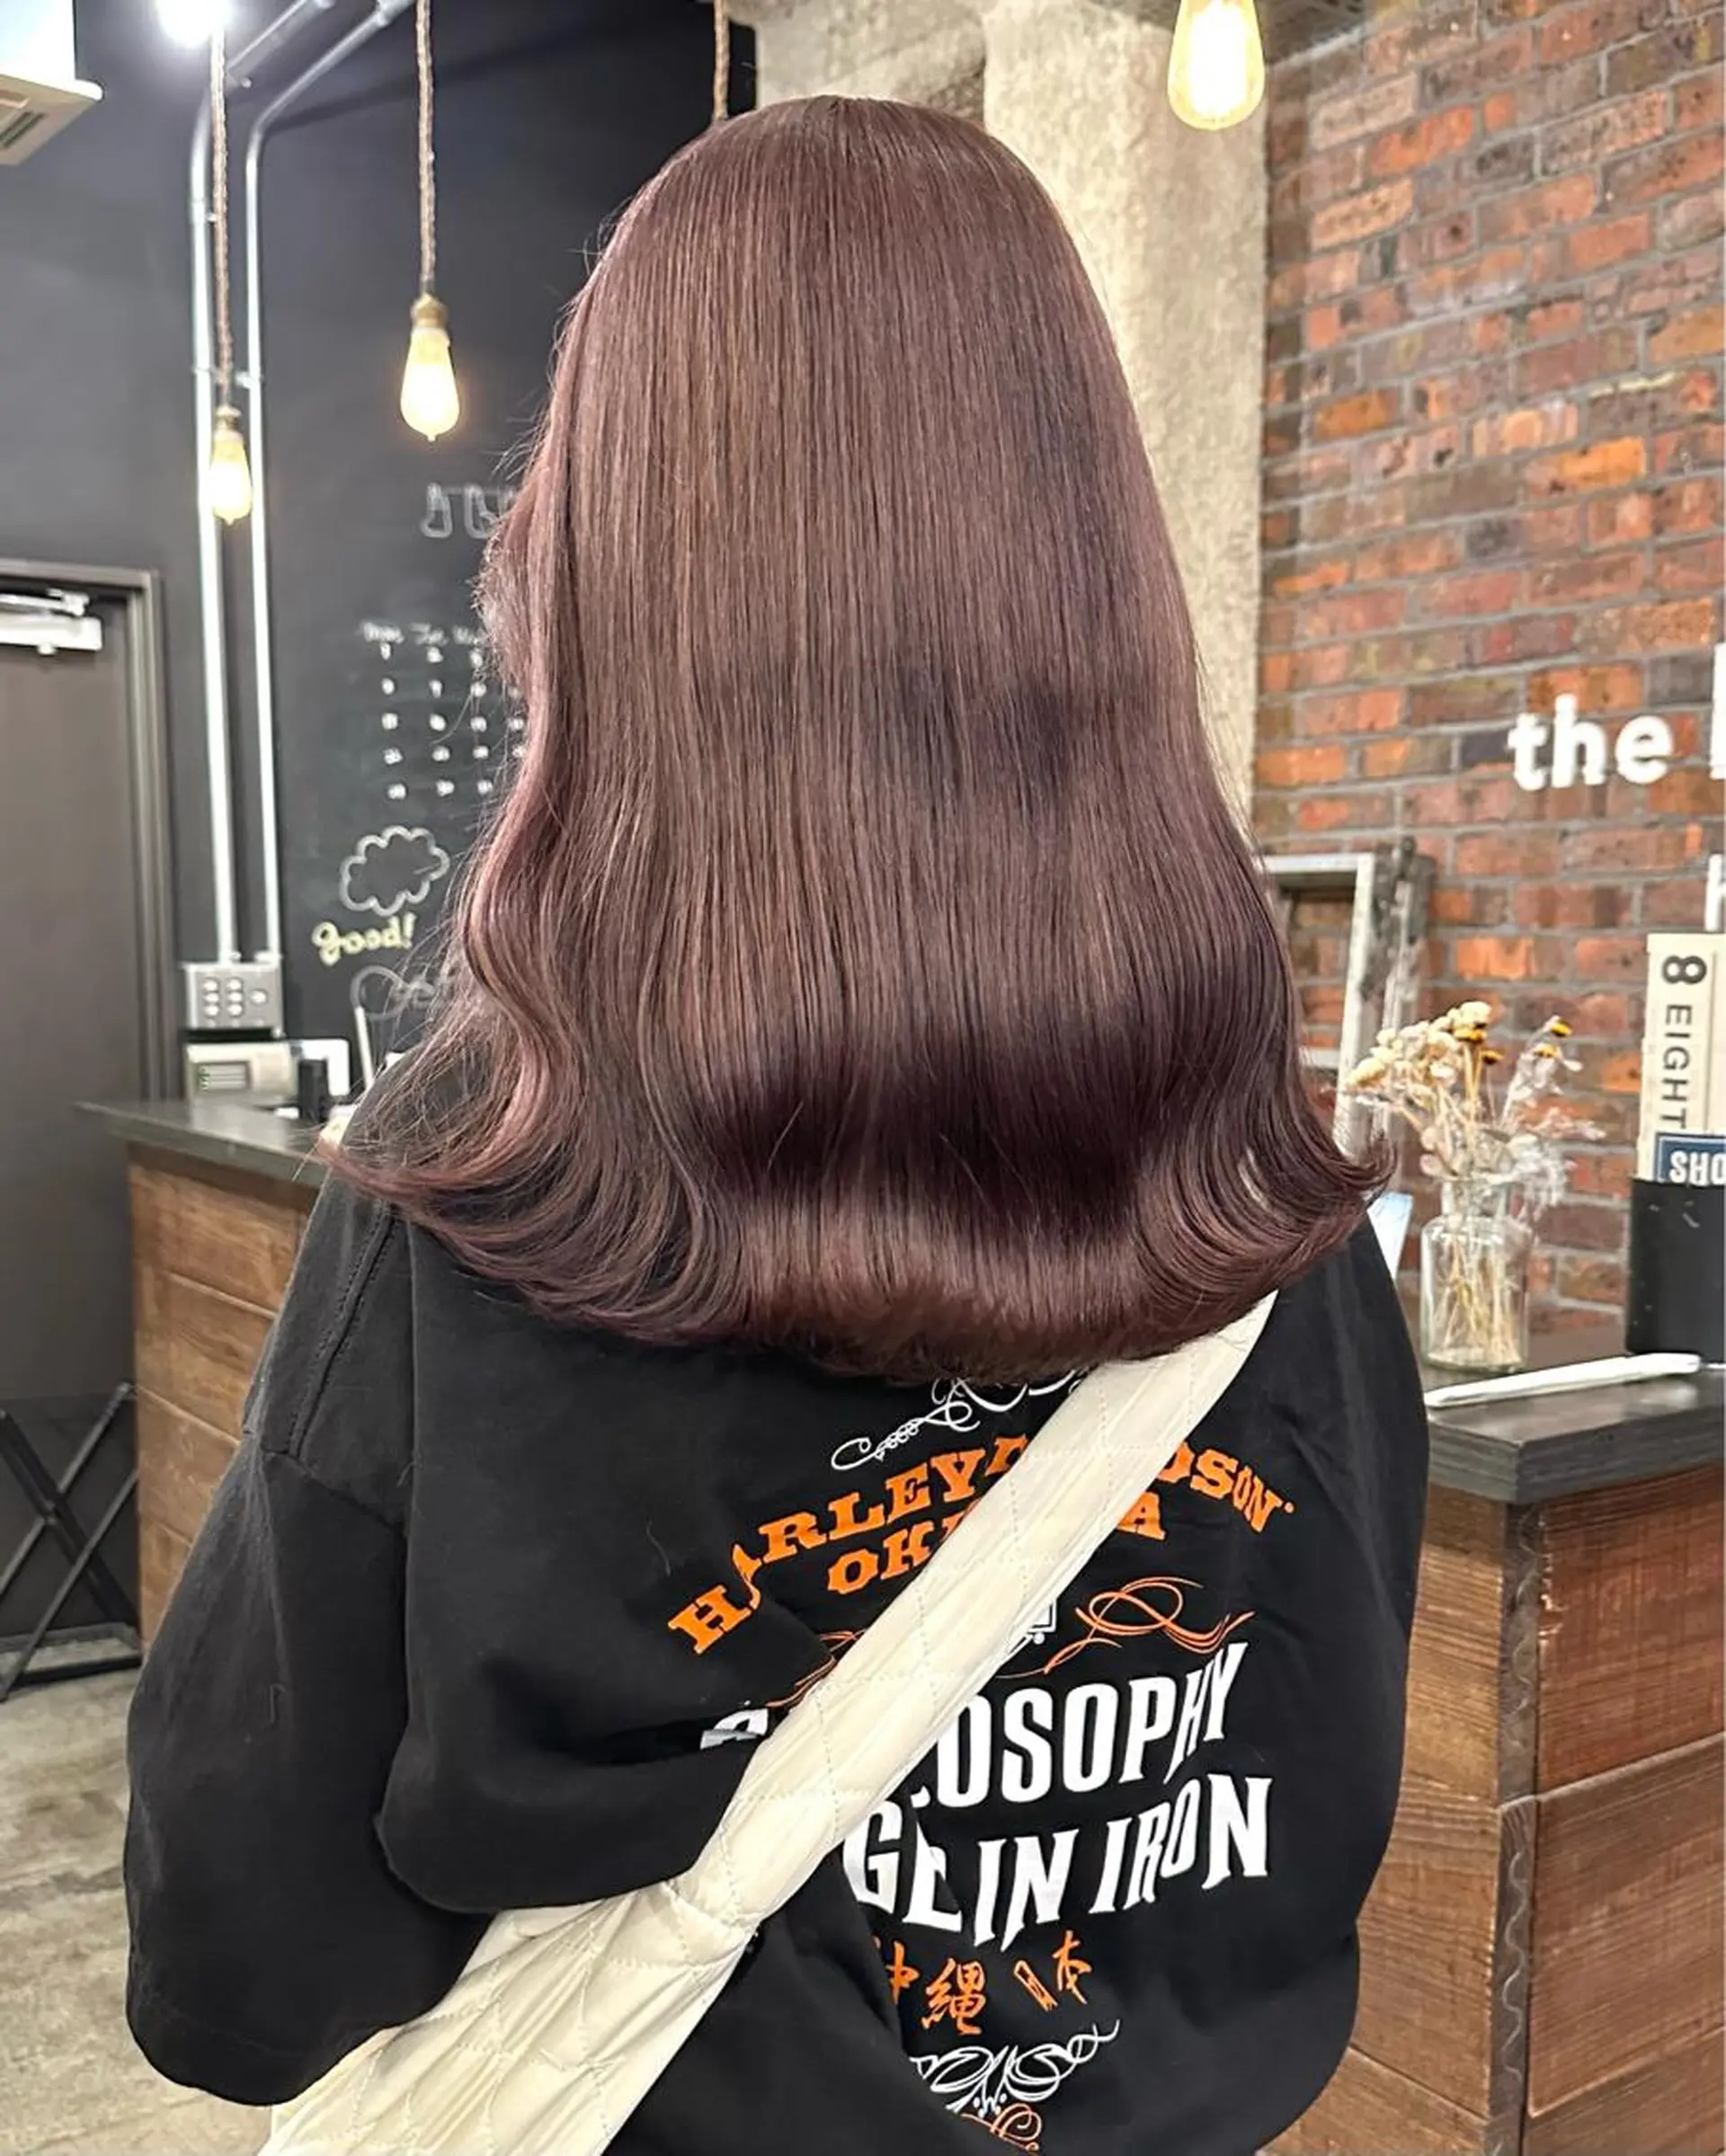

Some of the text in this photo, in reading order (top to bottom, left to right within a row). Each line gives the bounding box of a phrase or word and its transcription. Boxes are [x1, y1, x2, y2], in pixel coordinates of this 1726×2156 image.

[1507, 692, 1672, 791] the
[311, 912, 416, 967] good!
[1659, 954, 1707, 1130] 8 EIGHT
[910, 1641, 1250, 1808] OSOPHY
[973, 1828, 1080, 1953] IN
[1088, 1773, 1273, 1914] IRON
